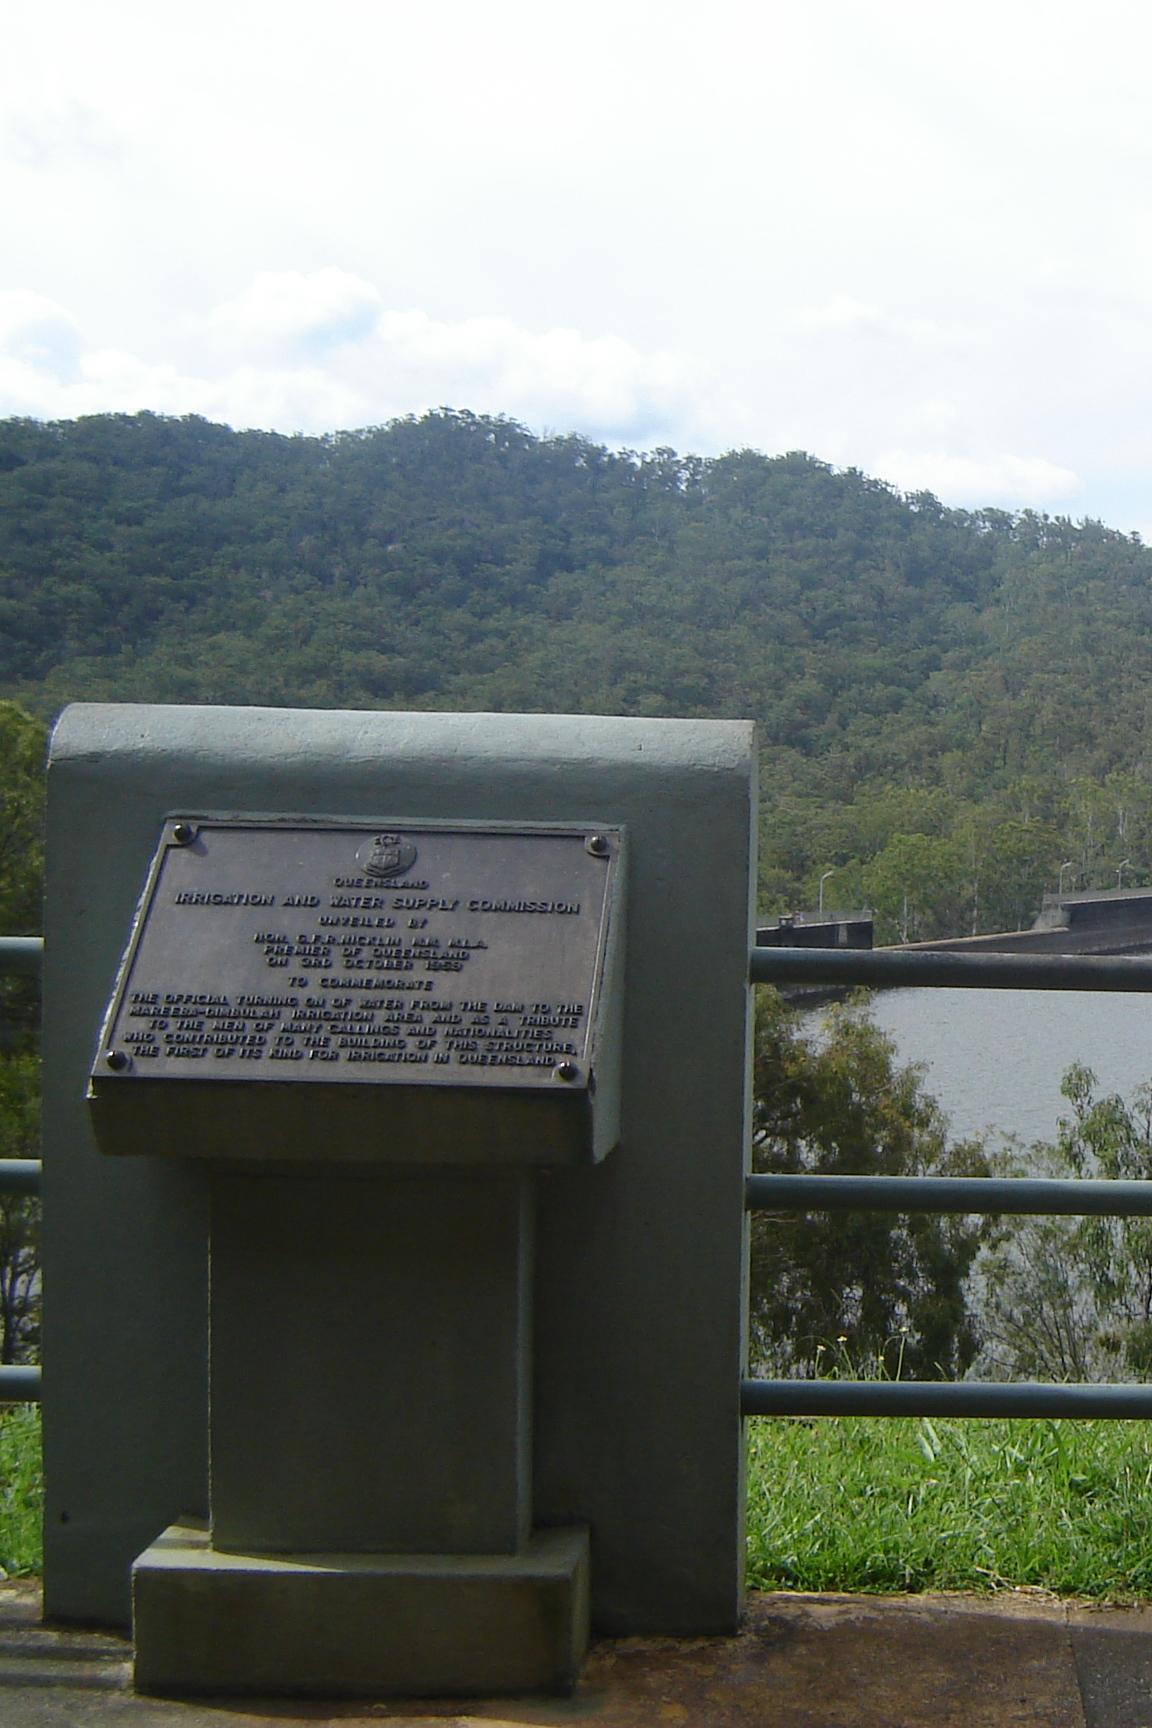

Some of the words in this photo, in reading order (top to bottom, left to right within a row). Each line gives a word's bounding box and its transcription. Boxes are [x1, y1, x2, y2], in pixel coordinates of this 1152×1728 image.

[335, 879, 429, 890] QUEENSLAND
[175, 893, 274, 906] IRRIGATION
[283, 895, 319, 907] AND
[331, 896, 383, 909] WATER
[392, 898, 459, 912] SUPPLY
[468, 900, 580, 914] COMMISSION
[318, 917, 395, 928] UNVEILED
[408, 918, 428, 929] BY
[264, 946, 330, 956] PREMIER
[343, 947, 362, 958] OF
[373, 948, 470, 960] QUEENSLAND
[267, 958, 288, 967] ON
[344, 959, 413, 970] OCTOBER
[289, 977, 308, 988] TO
[320, 976, 433, 991] COMMEMORATE
[133, 994, 159, 1004] THE
[165, 994, 228, 1006] OFFICIAL
[237, 995, 298, 1007] TURNING
[305, 997, 325, 1007] ON
[332, 998, 352, 1008] OF
[359, 999, 403, 1010] WATER
[410, 1000, 452, 1012] FROM
[460, 1001, 488, 1013] THE
[494, 1003, 523, 1014] DAM
[531, 1004, 551, 1014] TO
[556, 1004, 584, 1015] THE
[130, 1006, 281, 1020] MAREEBA-DIMBULAH
[292, 1009, 374, 1022] IRRIGATION
[385, 1013, 423, 1023] AREA
[432, 1014, 462, 1025] AND
[471, 1015, 490, 1025] AS
[497, 1016, 508, 1026] A
[519, 1016, 579, 1028] TRIBUTE
[150, 1020, 167, 1030] TO
[176, 1020, 203, 1031] THE
[212, 1021, 245, 1031] MEN
[255, 1022, 275, 1033] OF
[280, 1023, 323, 1033] MANY
[329, 1023, 400, 1035] CALLINGS
[408, 1026, 436, 1036] AND
[445, 1027, 553, 1040] NATIONALITIES
[124, 1032, 155, 1043] WHO
[164, 1033, 266, 1046] CONTRIBUTED
[275, 1036, 294, 1046] TO
[303, 1037, 331, 1048] THE
[339, 1037, 406, 1049] BUILDING
[417, 1040, 440, 1050] OF
[446, 1040, 478, 1052] THIS
[133, 1046, 159, 1057] THE
[167, 1046, 208, 1057] FIRST
[215, 1047, 235, 1058] OF
[240, 1048, 263, 1059] ITS
[270, 1049, 303, 1060] KIND
[309, 1050, 338, 1061] FOR
[346, 1051, 428, 1064] IRRIGATION
[434, 1052, 450, 1064] IN
